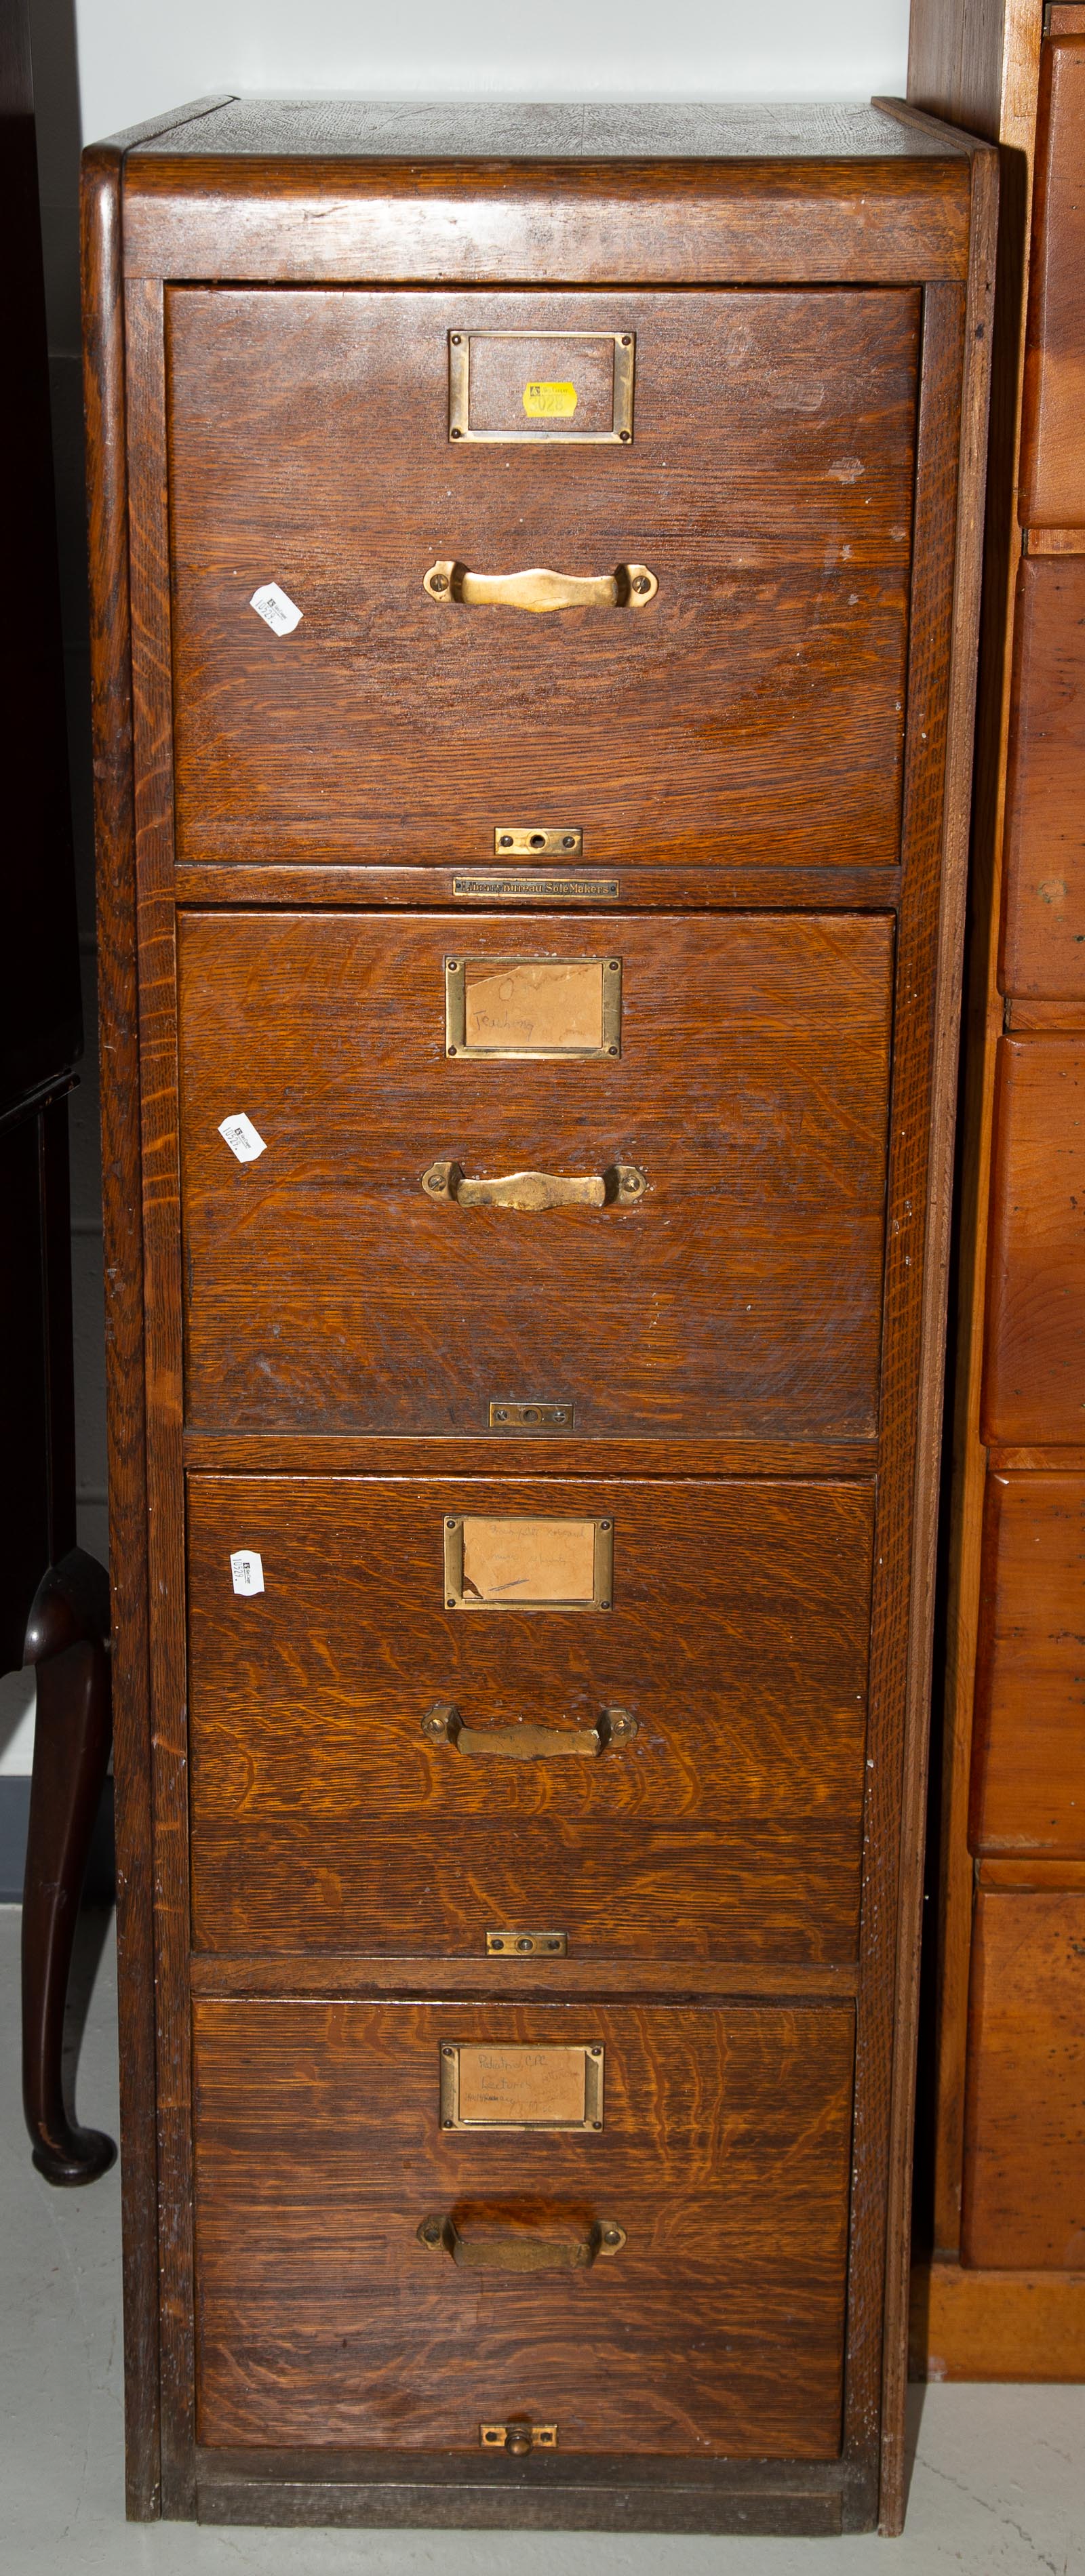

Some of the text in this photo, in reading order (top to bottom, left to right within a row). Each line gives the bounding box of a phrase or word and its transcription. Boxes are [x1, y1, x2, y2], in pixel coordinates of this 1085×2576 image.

[461, 881, 610, 893] Library Bureau Sole Makers
